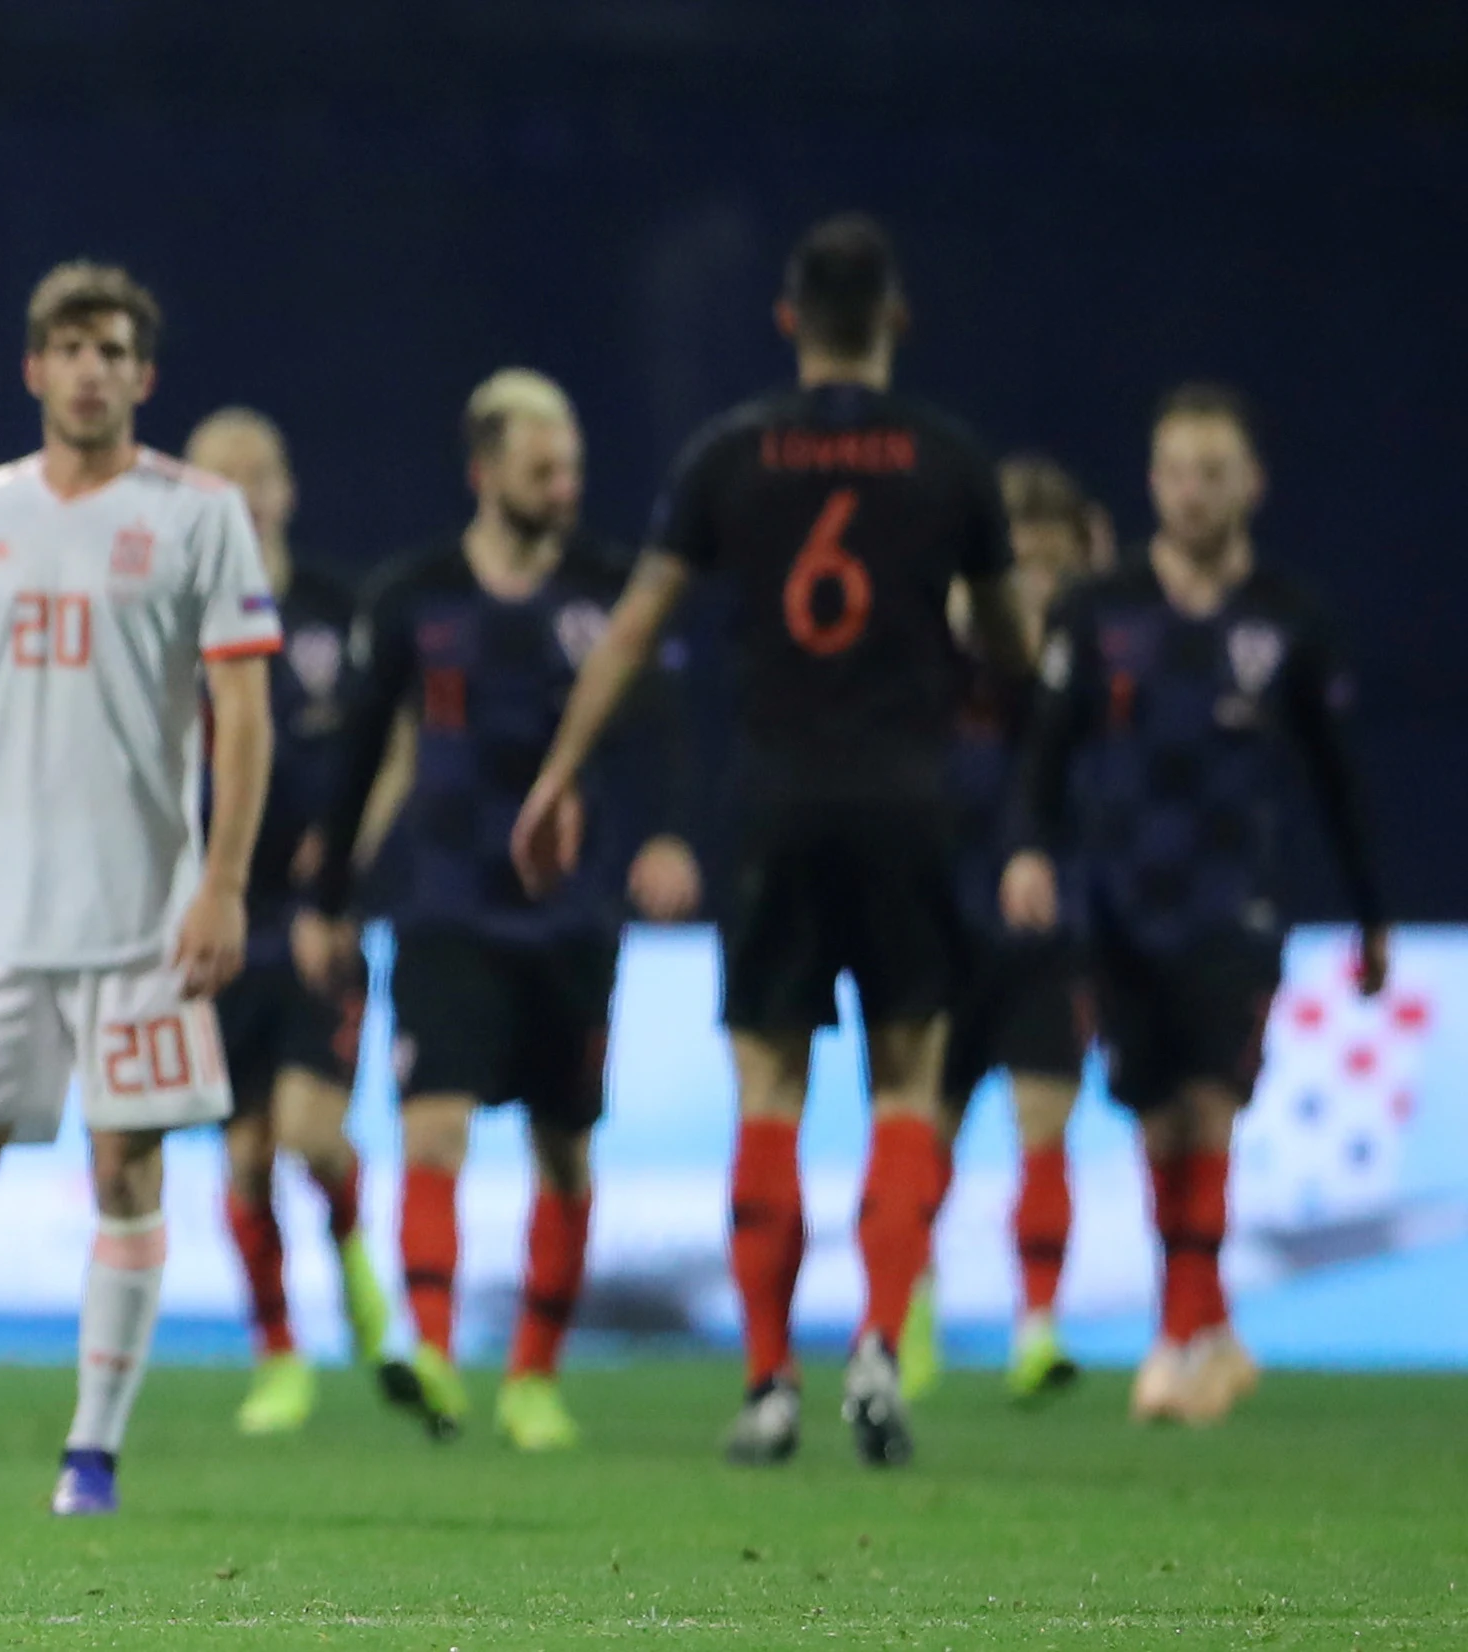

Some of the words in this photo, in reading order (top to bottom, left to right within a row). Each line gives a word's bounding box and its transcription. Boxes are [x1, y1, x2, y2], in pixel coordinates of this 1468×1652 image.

[783, 489, 872, 656] 6
[12, 591, 92, 669] 20
[103, 1015, 191, 1095] 20
